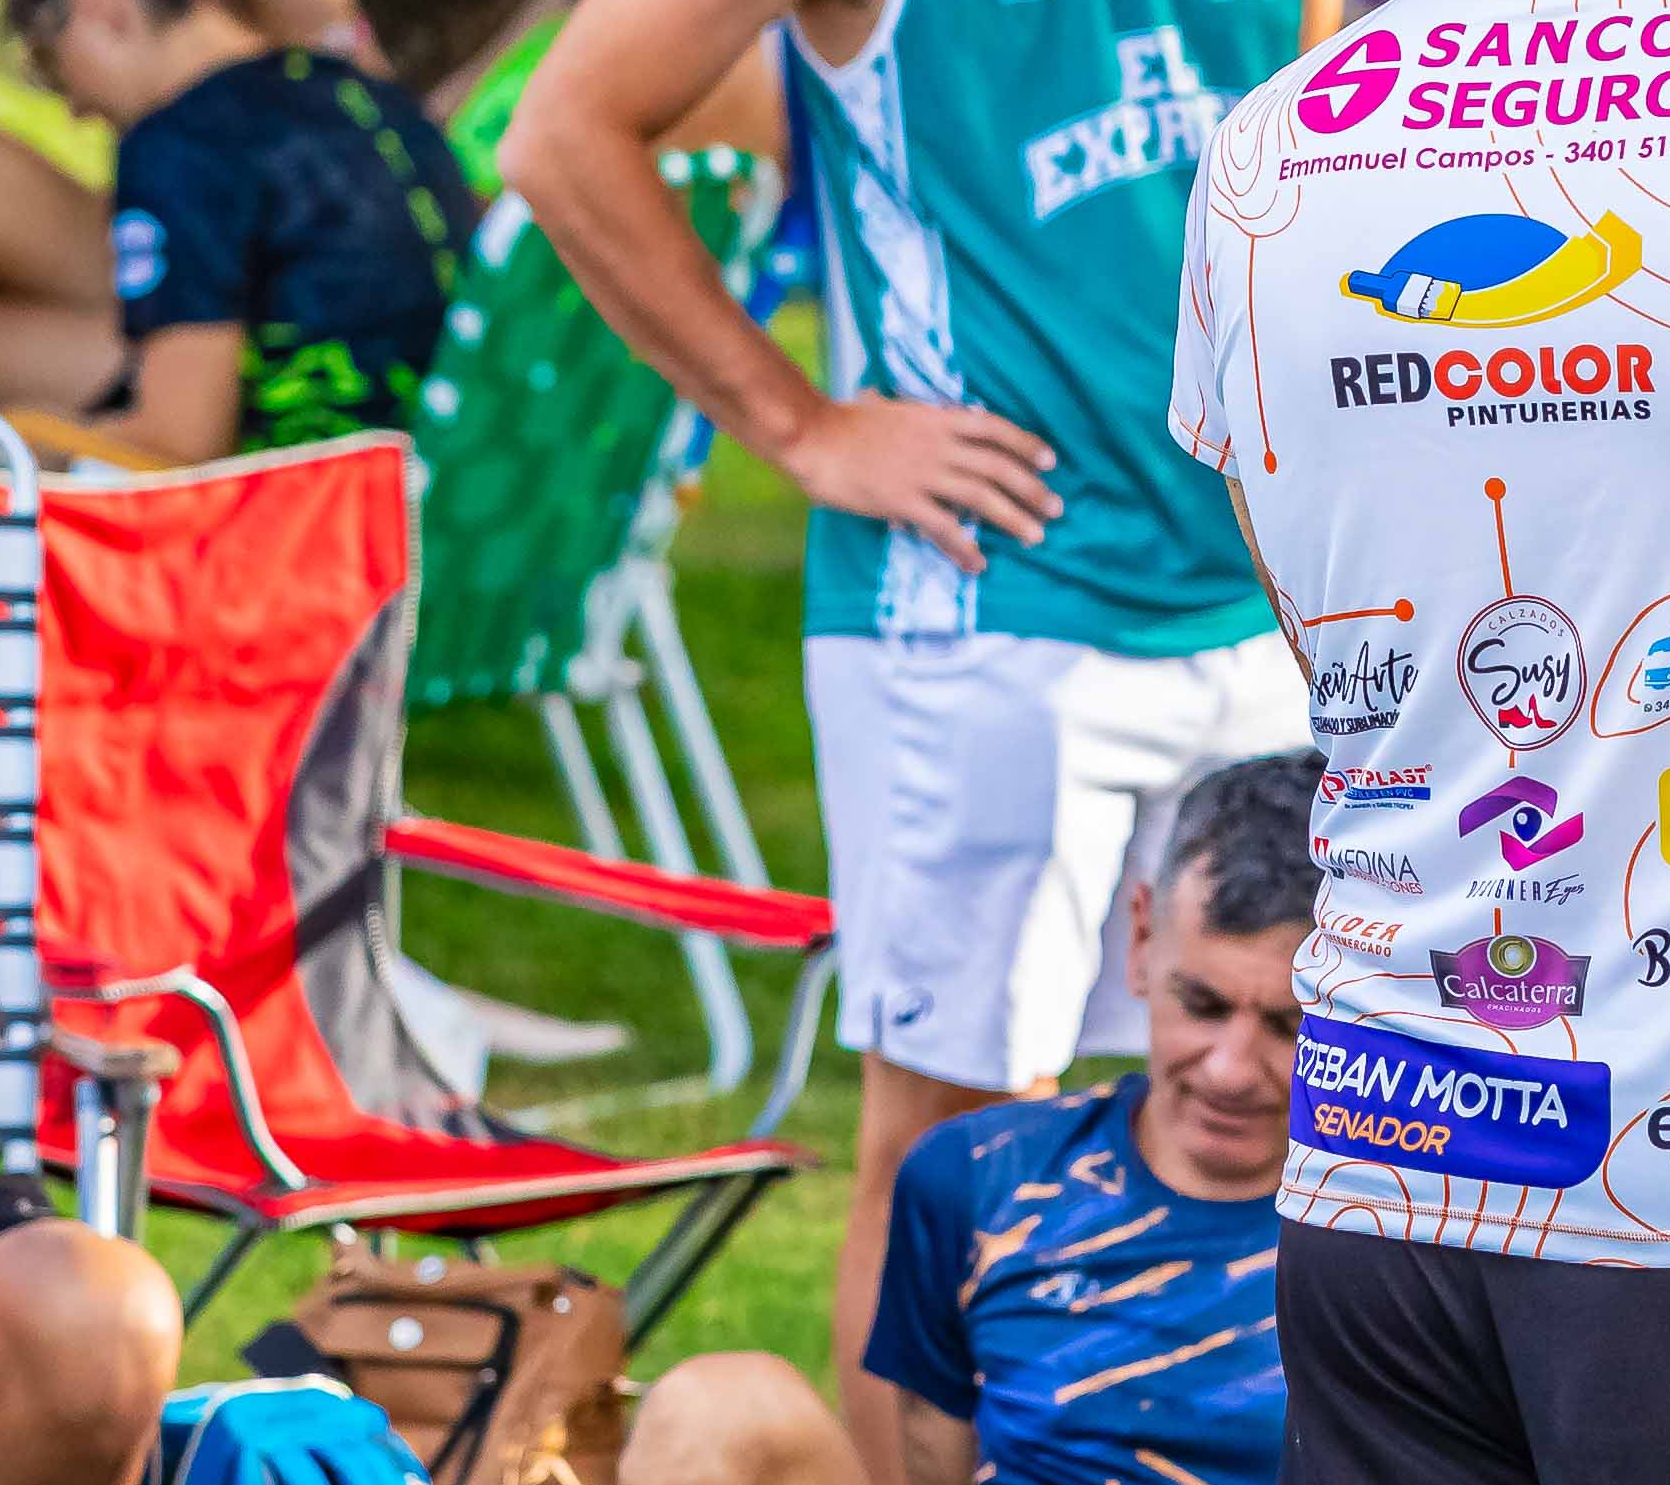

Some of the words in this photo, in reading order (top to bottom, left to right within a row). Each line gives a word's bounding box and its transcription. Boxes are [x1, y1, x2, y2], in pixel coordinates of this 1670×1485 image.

[1279, 147, 1406, 181] Emmanuel
[1415, 147, 1535, 173] Campos
[1564, 139, 1626, 164] 3401
[1330, 343, 1656, 409] REDCOLOR
[1446, 399, 1652, 428] PINTURERIAS
[1488, 608, 1565, 637] CALZADOS
[1467, 638, 1571, 706] Susy
[1329, 849, 1420, 883] MEDINA
[1544, 873, 1585, 906] Eyes
[1443, 974, 1577, 1005] Calcaterra
[1410, 1064, 1569, 1130] MOTTA
[1314, 1102, 1451, 1156] SENADOR
